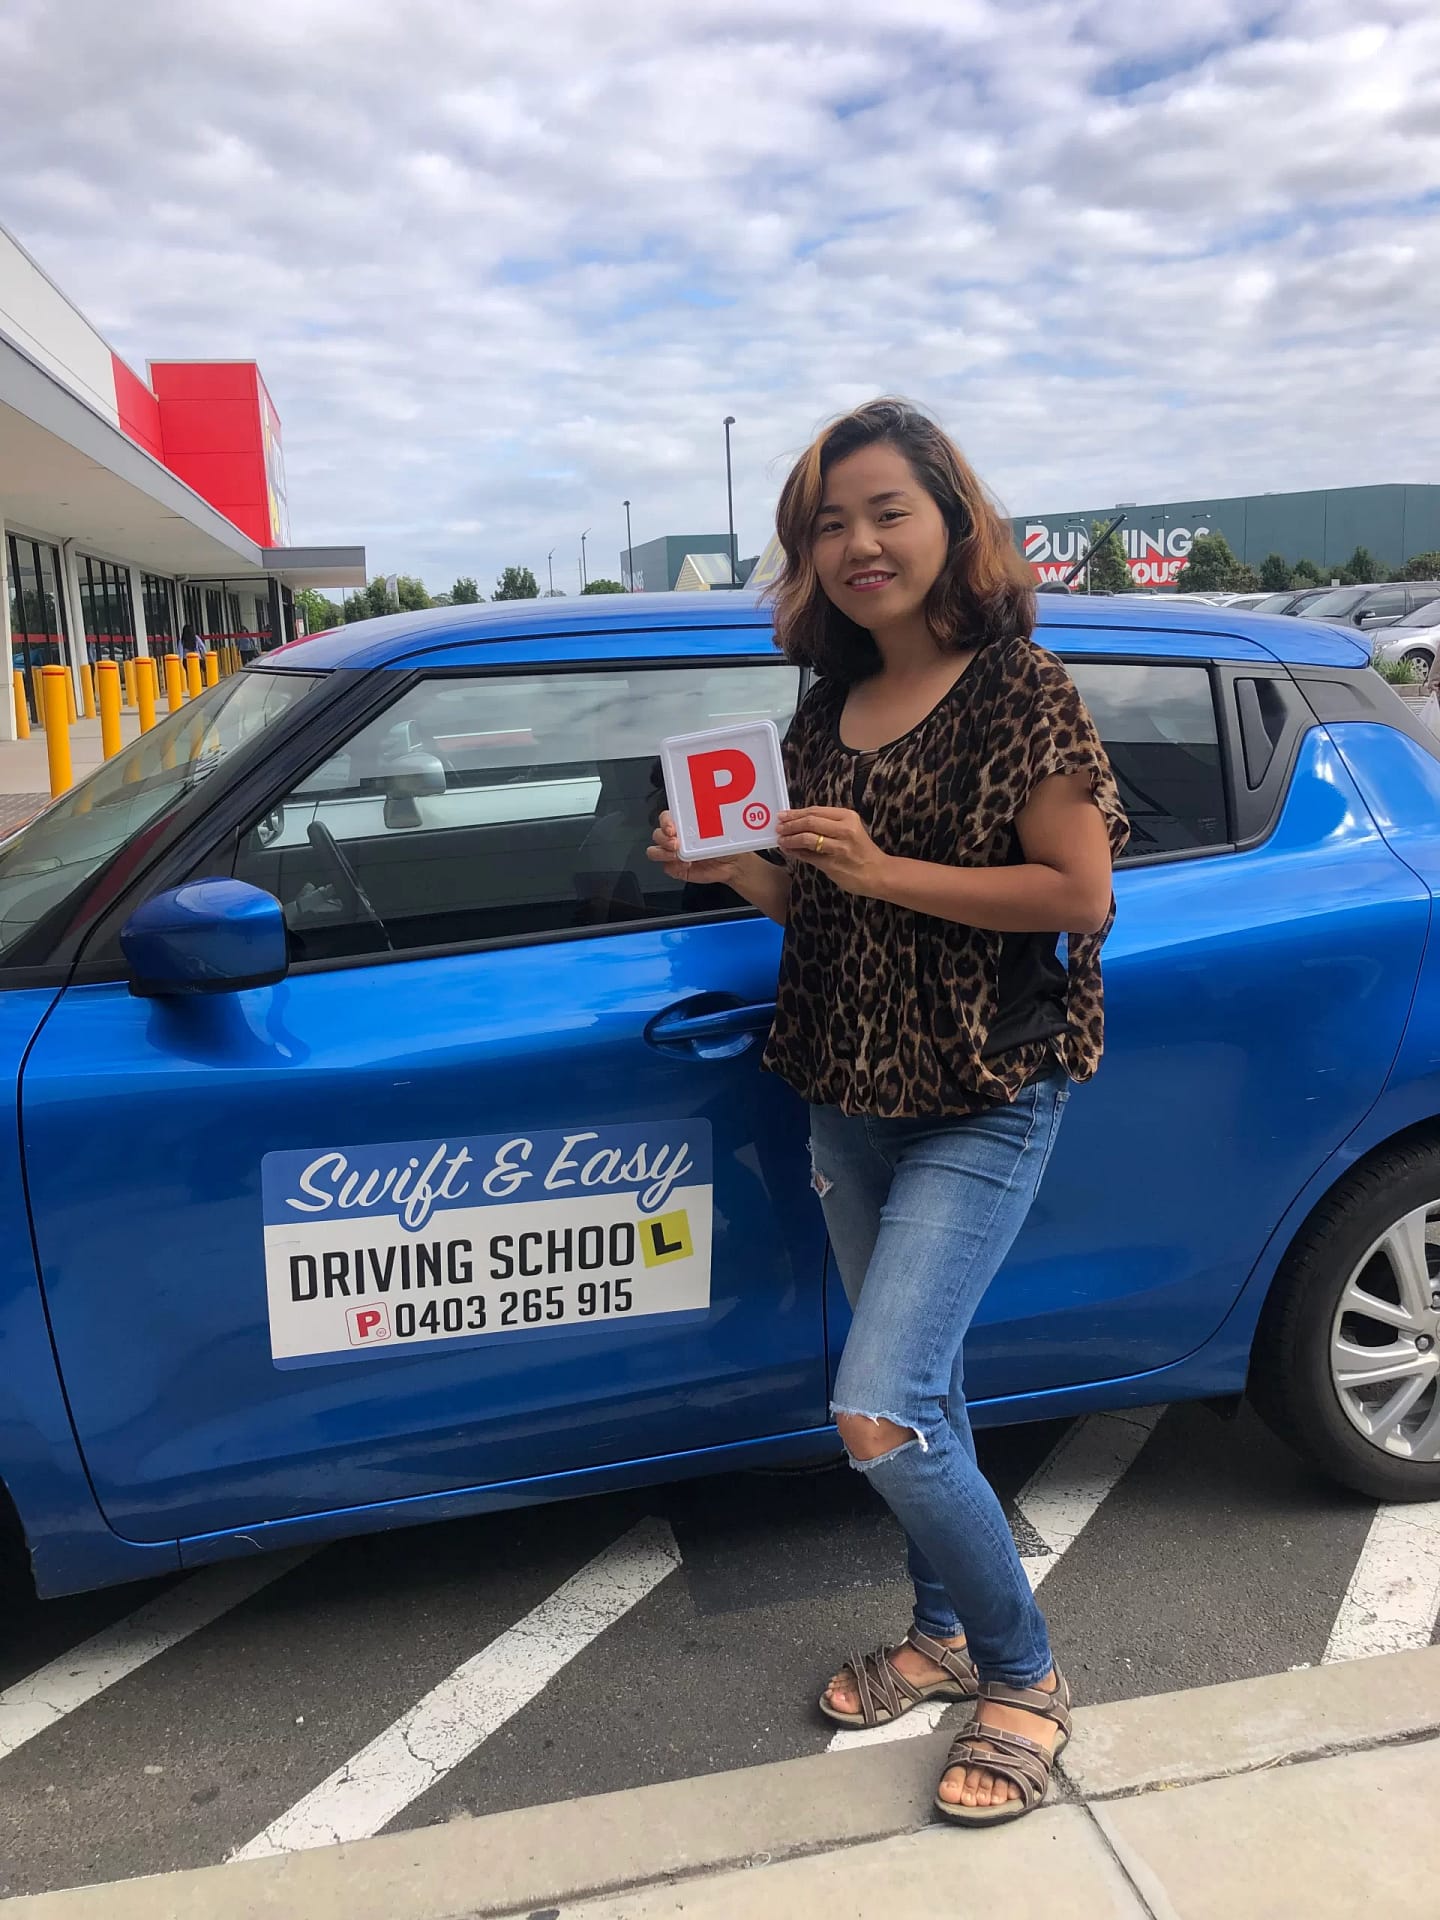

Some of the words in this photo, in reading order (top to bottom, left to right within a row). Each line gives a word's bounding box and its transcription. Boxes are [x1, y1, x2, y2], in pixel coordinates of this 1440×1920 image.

[687, 749, 756, 839] P
[749, 810, 765, 823] 90
[286, 1143, 473, 1228] Swift
[483, 1138, 533, 1197] &
[544, 1132, 693, 1213] Easy
[290, 1239, 473, 1302] DRIVING
[356, 1310, 381, 1338] P
[395, 1294, 487, 1338] 0403
[500, 1286, 565, 1326] 265
[577, 1278, 633, 1317] 915
